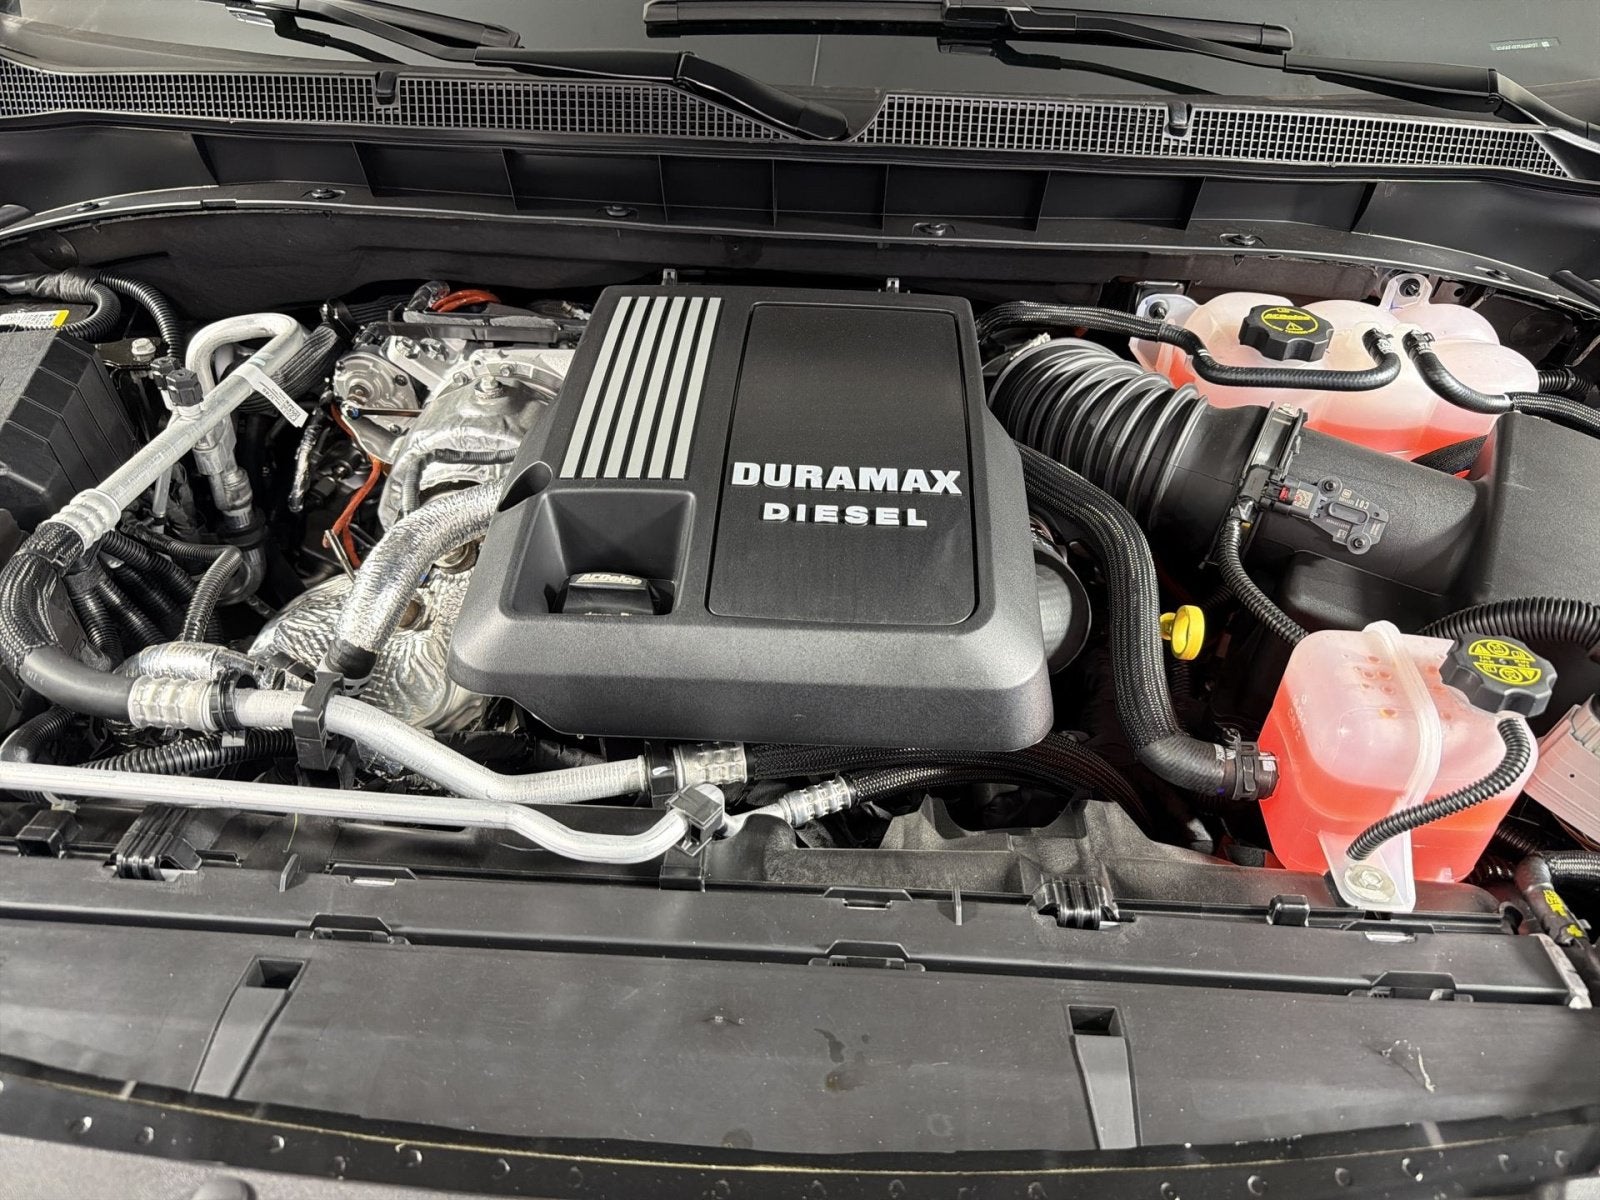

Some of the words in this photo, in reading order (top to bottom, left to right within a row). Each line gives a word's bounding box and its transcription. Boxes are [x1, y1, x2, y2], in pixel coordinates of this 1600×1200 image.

[731, 462, 962, 495] DURAMAX
[763, 502, 928, 527] DIESEL
[576, 573, 643, 586] ACDelco
